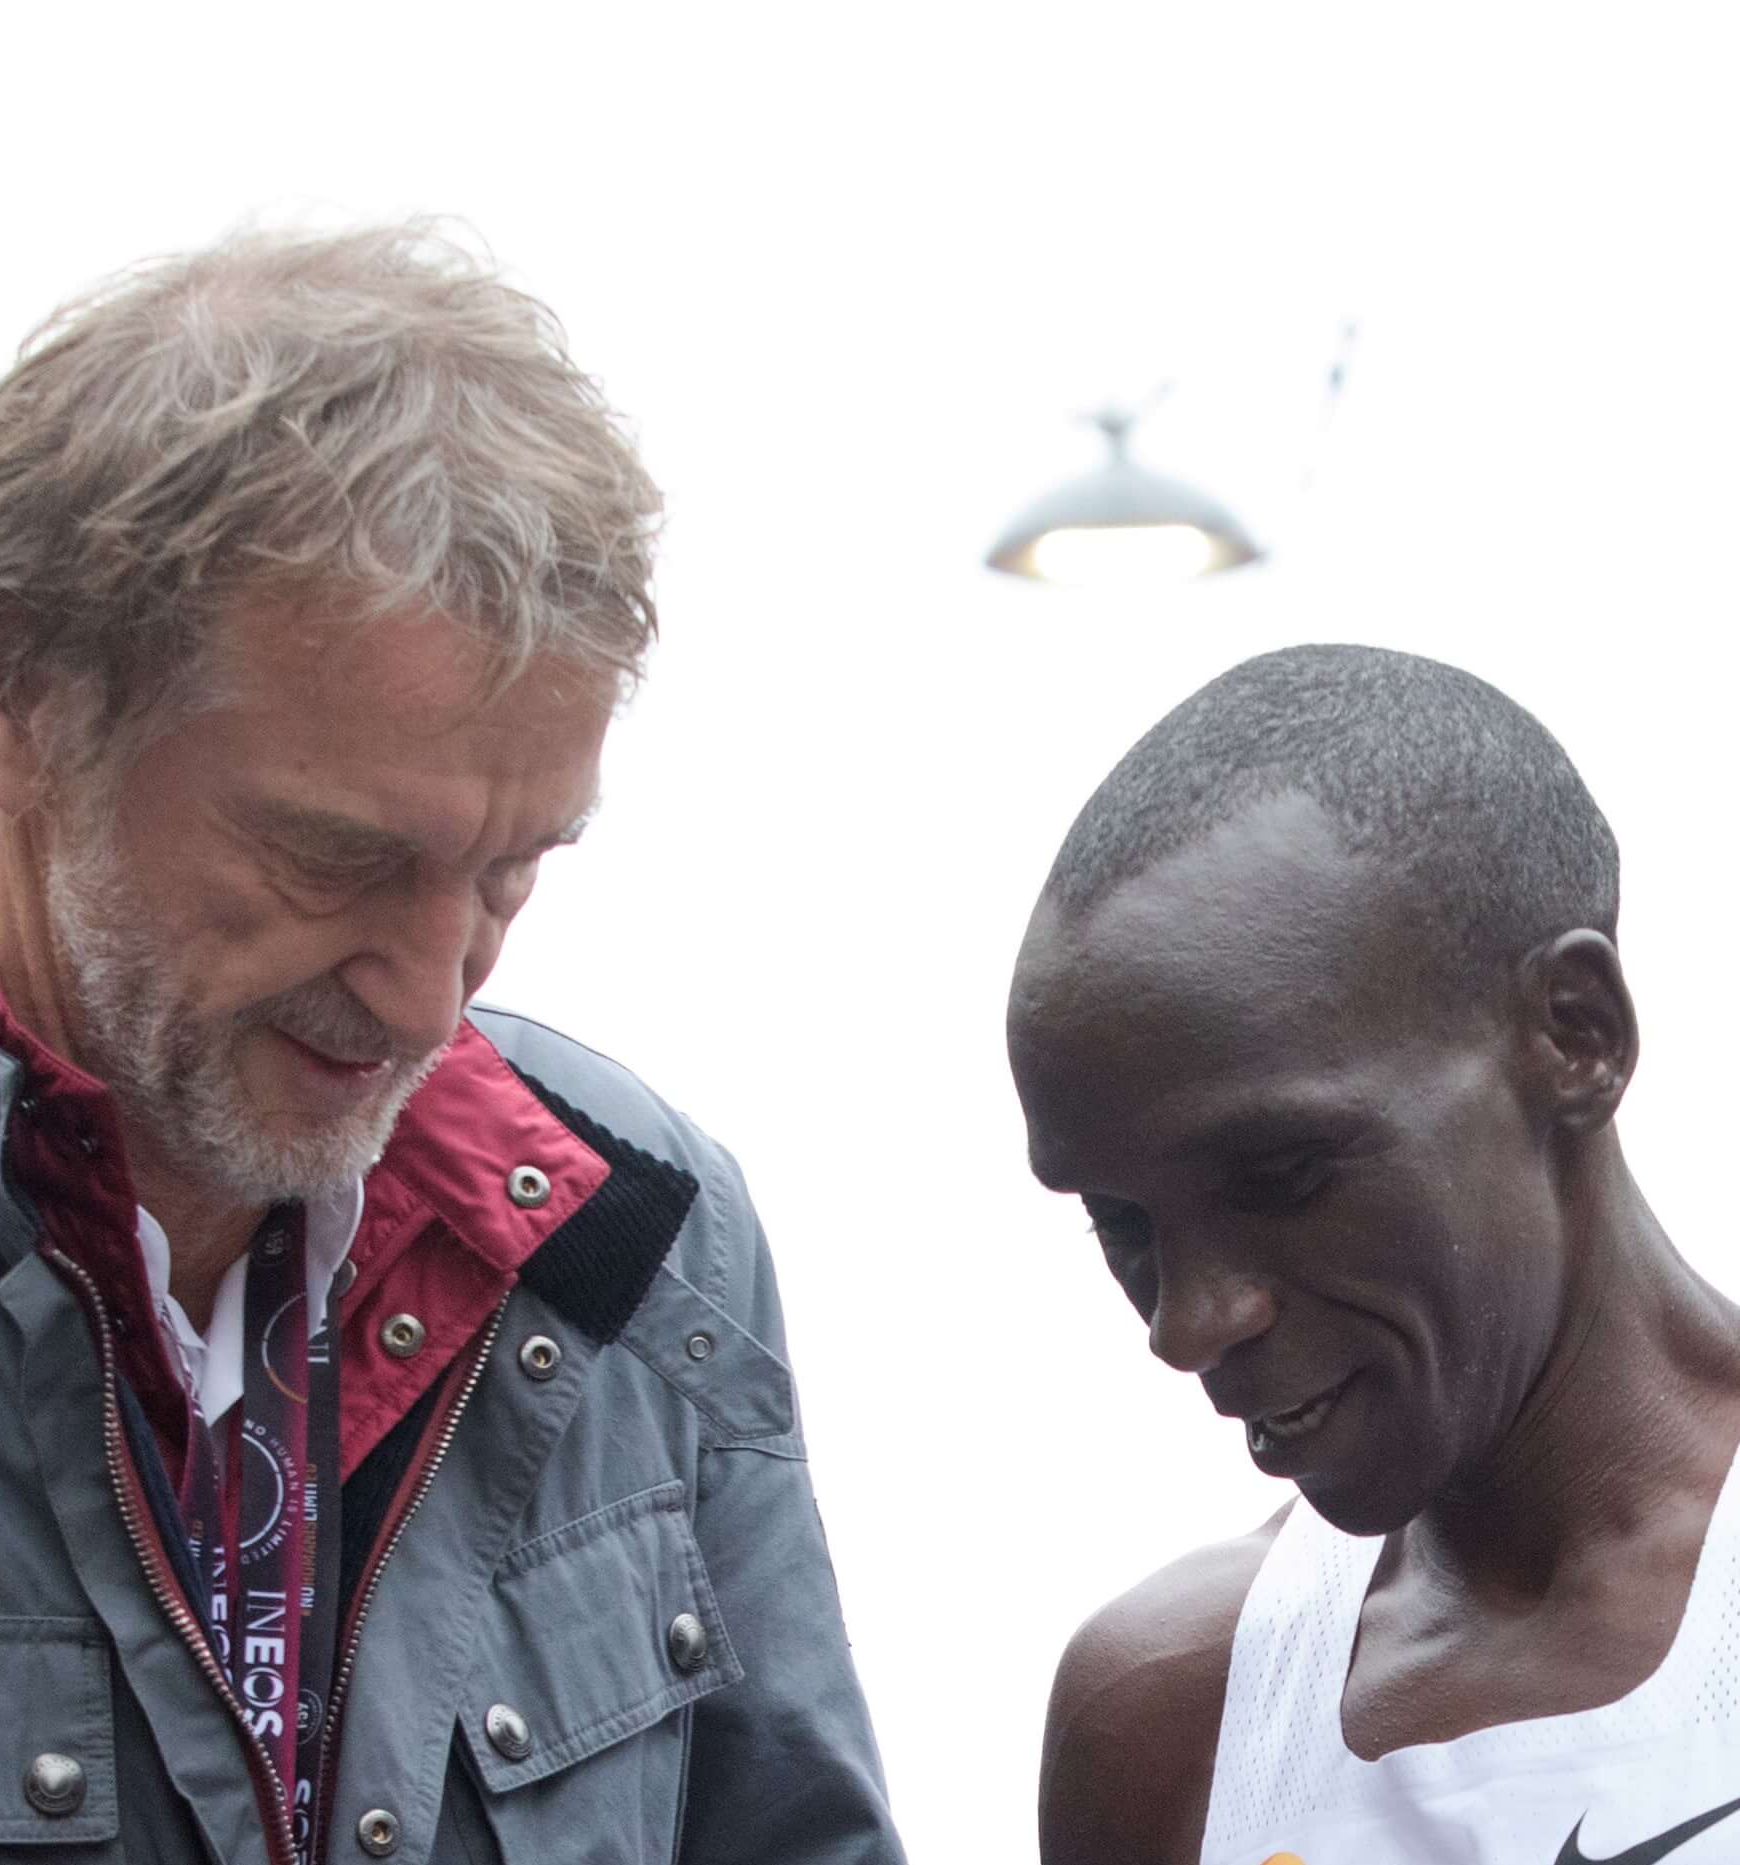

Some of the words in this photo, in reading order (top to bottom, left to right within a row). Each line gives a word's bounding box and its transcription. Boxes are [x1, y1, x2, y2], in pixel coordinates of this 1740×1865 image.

[243, 1418, 266, 1436] NO
[269, 1437, 300, 1491] HUMAN
[286, 1499, 299, 1513] IS
[239, 1519, 293, 1566] LIMITED
[242, 1588, 287, 1738] INEOS
